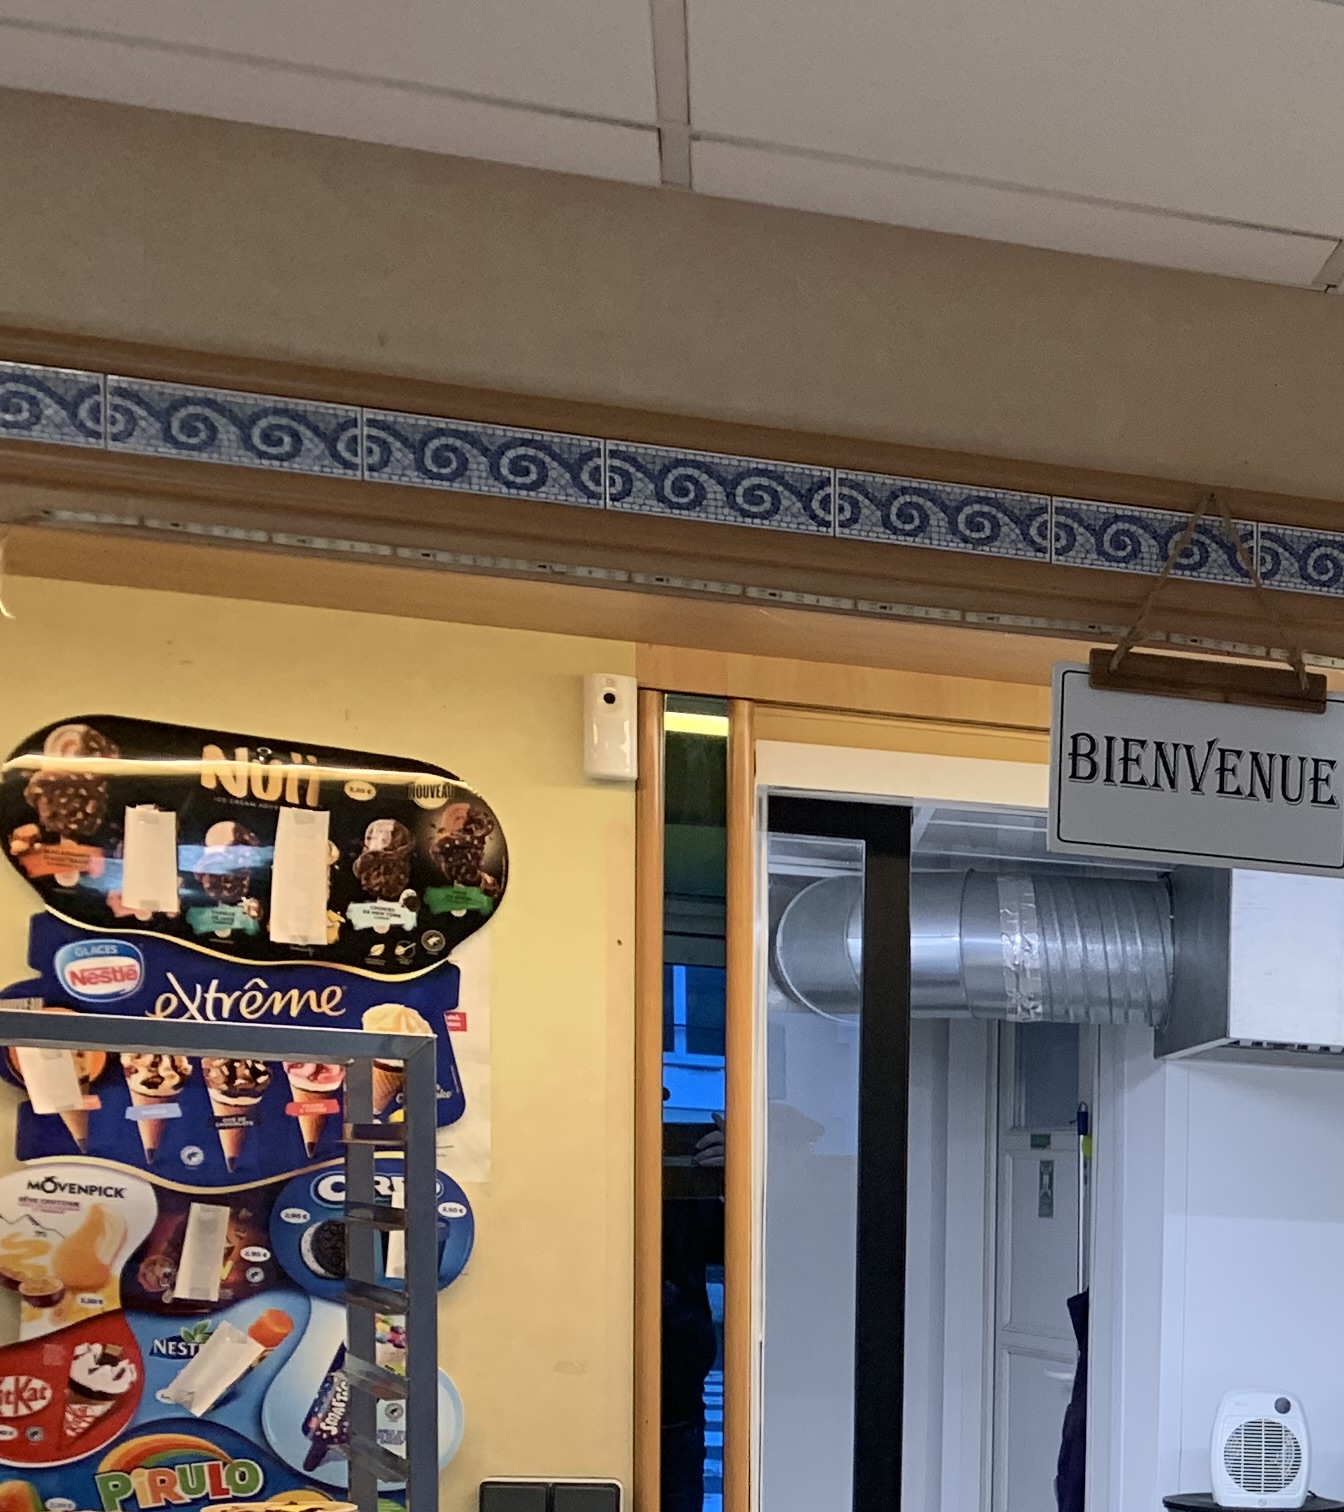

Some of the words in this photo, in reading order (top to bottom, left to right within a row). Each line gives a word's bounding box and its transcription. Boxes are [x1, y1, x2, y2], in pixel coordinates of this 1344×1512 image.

[1068, 732, 1339, 808] BIENVENUE
[74, 944, 118, 957] GLACES
[27, 1176, 125, 1198] MÖVENPICK
